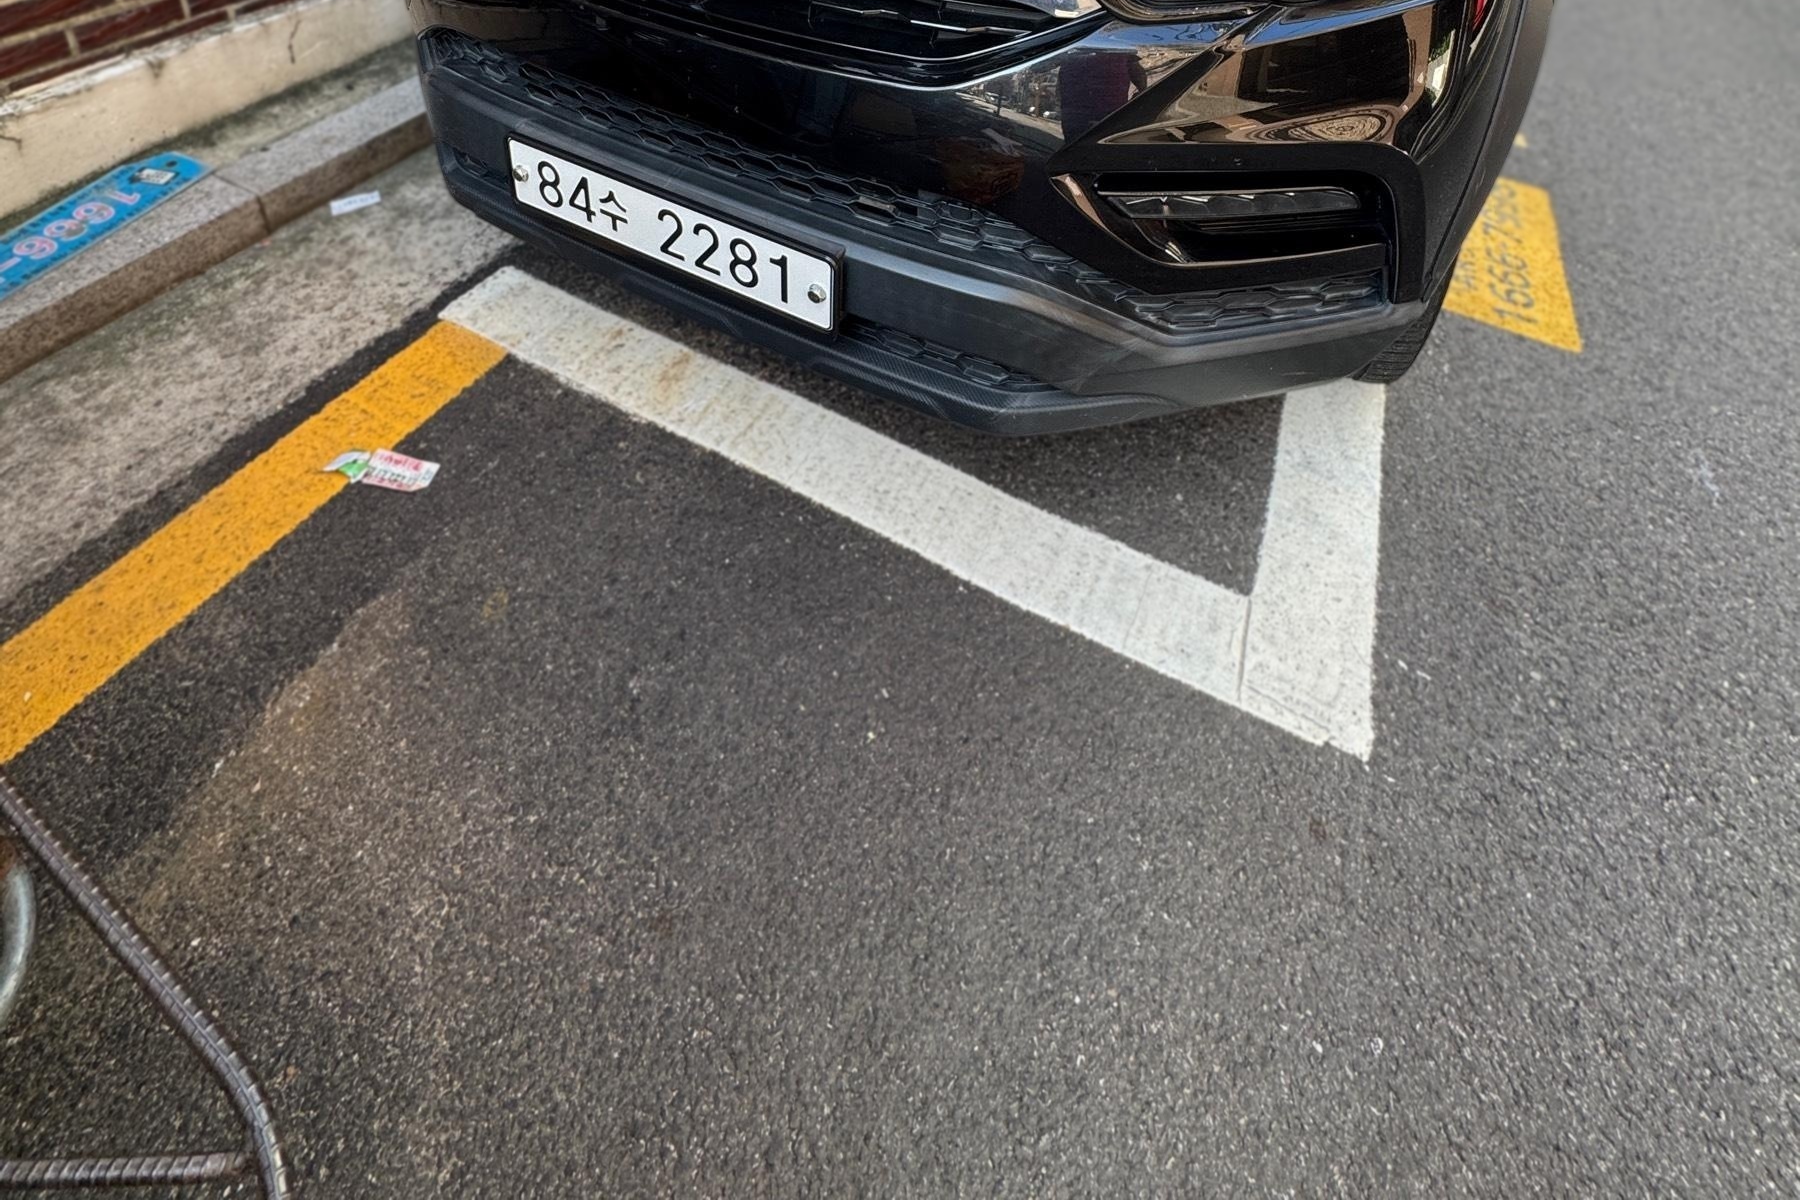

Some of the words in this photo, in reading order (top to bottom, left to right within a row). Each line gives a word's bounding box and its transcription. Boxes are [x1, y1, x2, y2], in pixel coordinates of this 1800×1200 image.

[0, 189, 141, 283] 1666-
[537, 160, 629, 232] 84수
[657, 208, 789, 303] 2281
